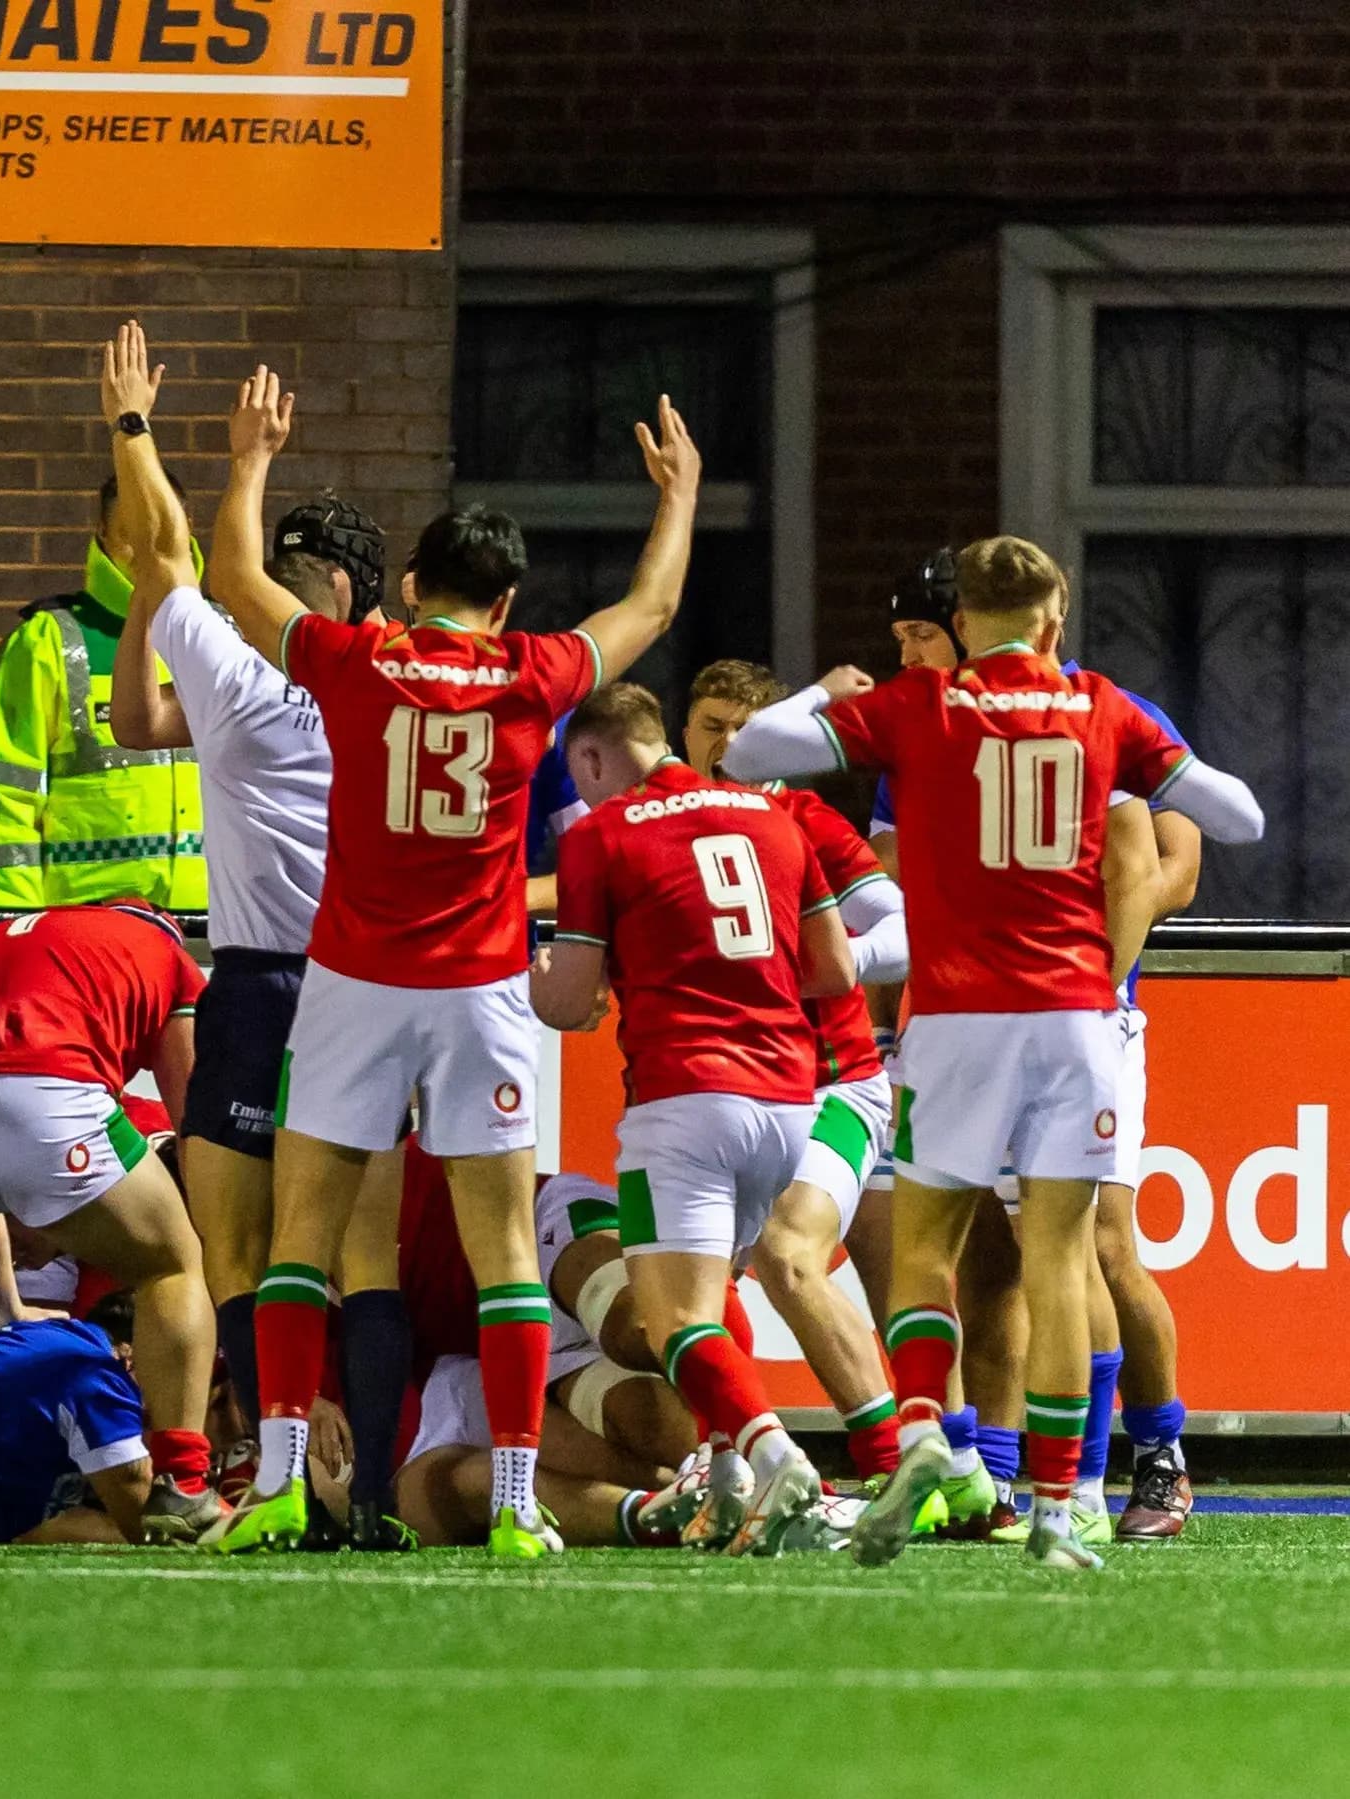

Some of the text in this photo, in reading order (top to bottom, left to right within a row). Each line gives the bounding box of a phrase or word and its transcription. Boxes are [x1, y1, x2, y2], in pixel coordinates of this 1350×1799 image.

[306, 12, 416, 67] LTD
[63, 115, 172, 143] SHEET
[180, 118, 372, 151] MATERIALS,
[294, 711, 321, 733] FLY
[382, 705, 495, 839] 13
[973, 737, 1085, 871] 10
[692, 833, 775, 961] 9
